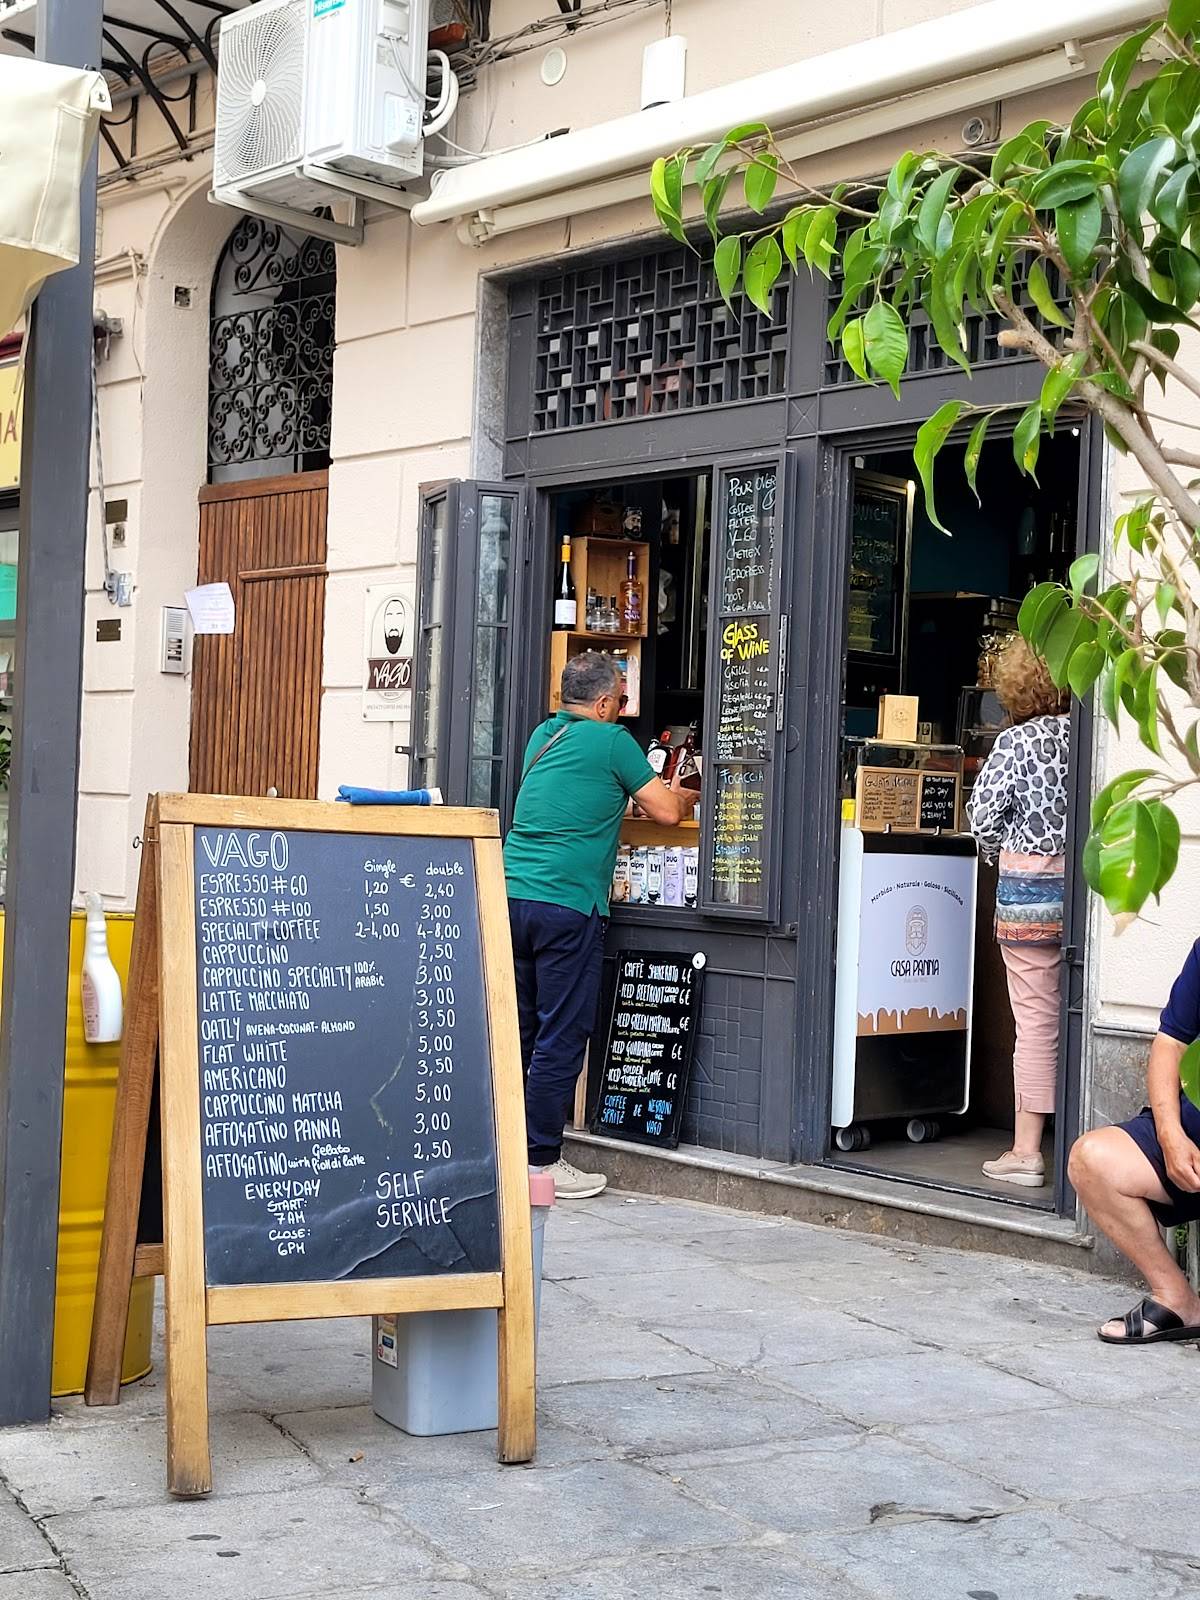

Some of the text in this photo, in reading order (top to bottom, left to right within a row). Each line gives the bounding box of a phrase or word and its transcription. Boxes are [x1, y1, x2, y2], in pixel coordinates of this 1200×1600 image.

[374, 658, 411, 689] VAGO
[202, 832, 289, 871] VAGO
[364, 859, 396, 878] Single
[425, 862, 465, 877] double
[200, 873, 269, 894] ESPRESSO
[365, 880, 388, 897] 1,20
[425, 883, 455, 899] 2,40
[896, 881, 920, 890] Naturale
[200, 897, 267, 918] ESPRESSO
[365, 903, 389, 917] 1,50
[421, 904, 451, 920] 3,00
[273, 919, 321, 941] COFFEE
[416, 922, 461, 940] 4-8,00
[419, 943, 453, 960] 2,50
[415, 965, 452, 985] 3,00
[890, 959, 940, 977] CASA PANNA
[202, 990, 244, 1013] LATTE
[416, 987, 455, 1006] 3,00
[201, 1017, 240, 1041] OATLY
[417, 1010, 456, 1028] 3,50
[203, 1043, 235, 1064] FLAT
[418, 1035, 453, 1052] 5,00
[417, 1056, 453, 1075] 3,50
[292, 1091, 343, 1113] MATCHA
[415, 1083, 452, 1103] 5,00
[294, 1117, 341, 1142] PANNA
[413, 1112, 450, 1134] 3,00
[288, 1156, 311, 1169] with
[413, 1140, 452, 1159] 2,50
[312, 1143, 350, 1159] Gelato
[245, 1178, 321, 1200] EVERYDAY
[376, 1170, 424, 1200] SELF
[267, 1199, 308, 1212] START:
[269, 1229, 311, 1241] CLOSE:
[278, 1242, 305, 1256] 6PM
